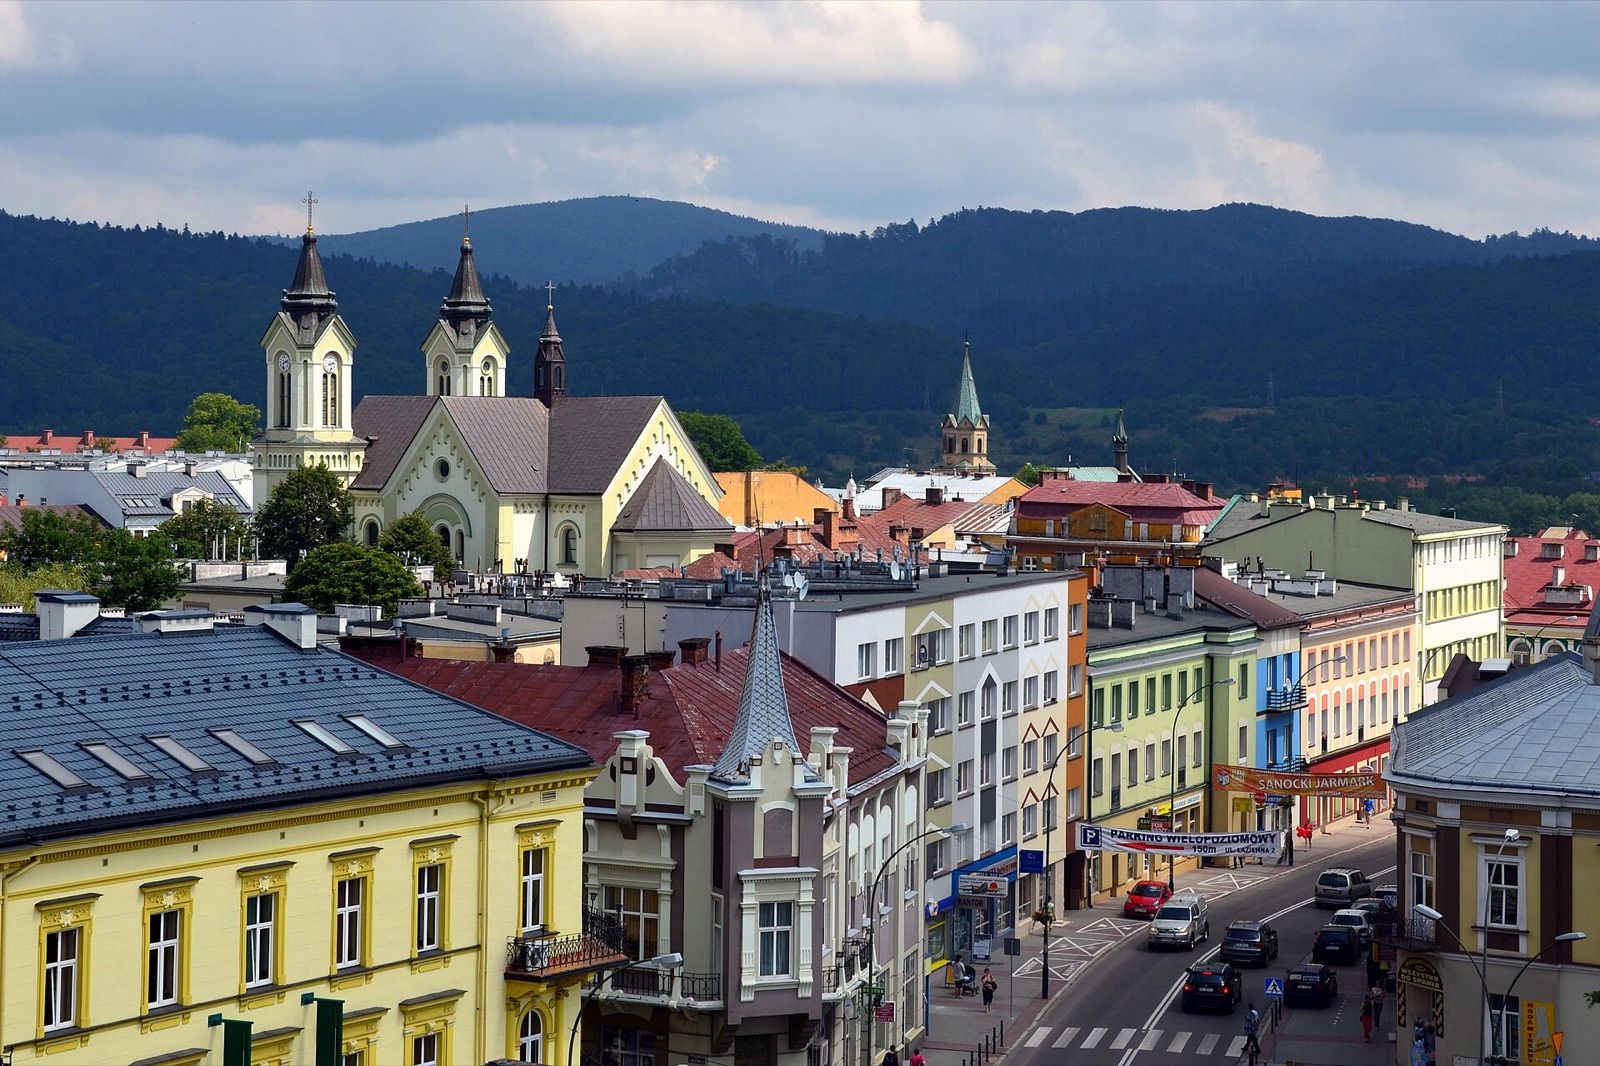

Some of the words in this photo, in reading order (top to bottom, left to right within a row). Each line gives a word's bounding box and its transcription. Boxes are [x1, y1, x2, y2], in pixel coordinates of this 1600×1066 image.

[1258, 779, 1311, 790] SANOCKI
[1315, 776, 1375, 788] JARMARK
[1110, 829, 1163, 843] PARKING
[1165, 832, 1277, 844] WIELOPOZIOMOWY
[958, 898, 984, 907] KANTOR
[1401, 968, 1439, 982] WSZYSTKO
[1412, 977, 1440, 989] SPANIA
